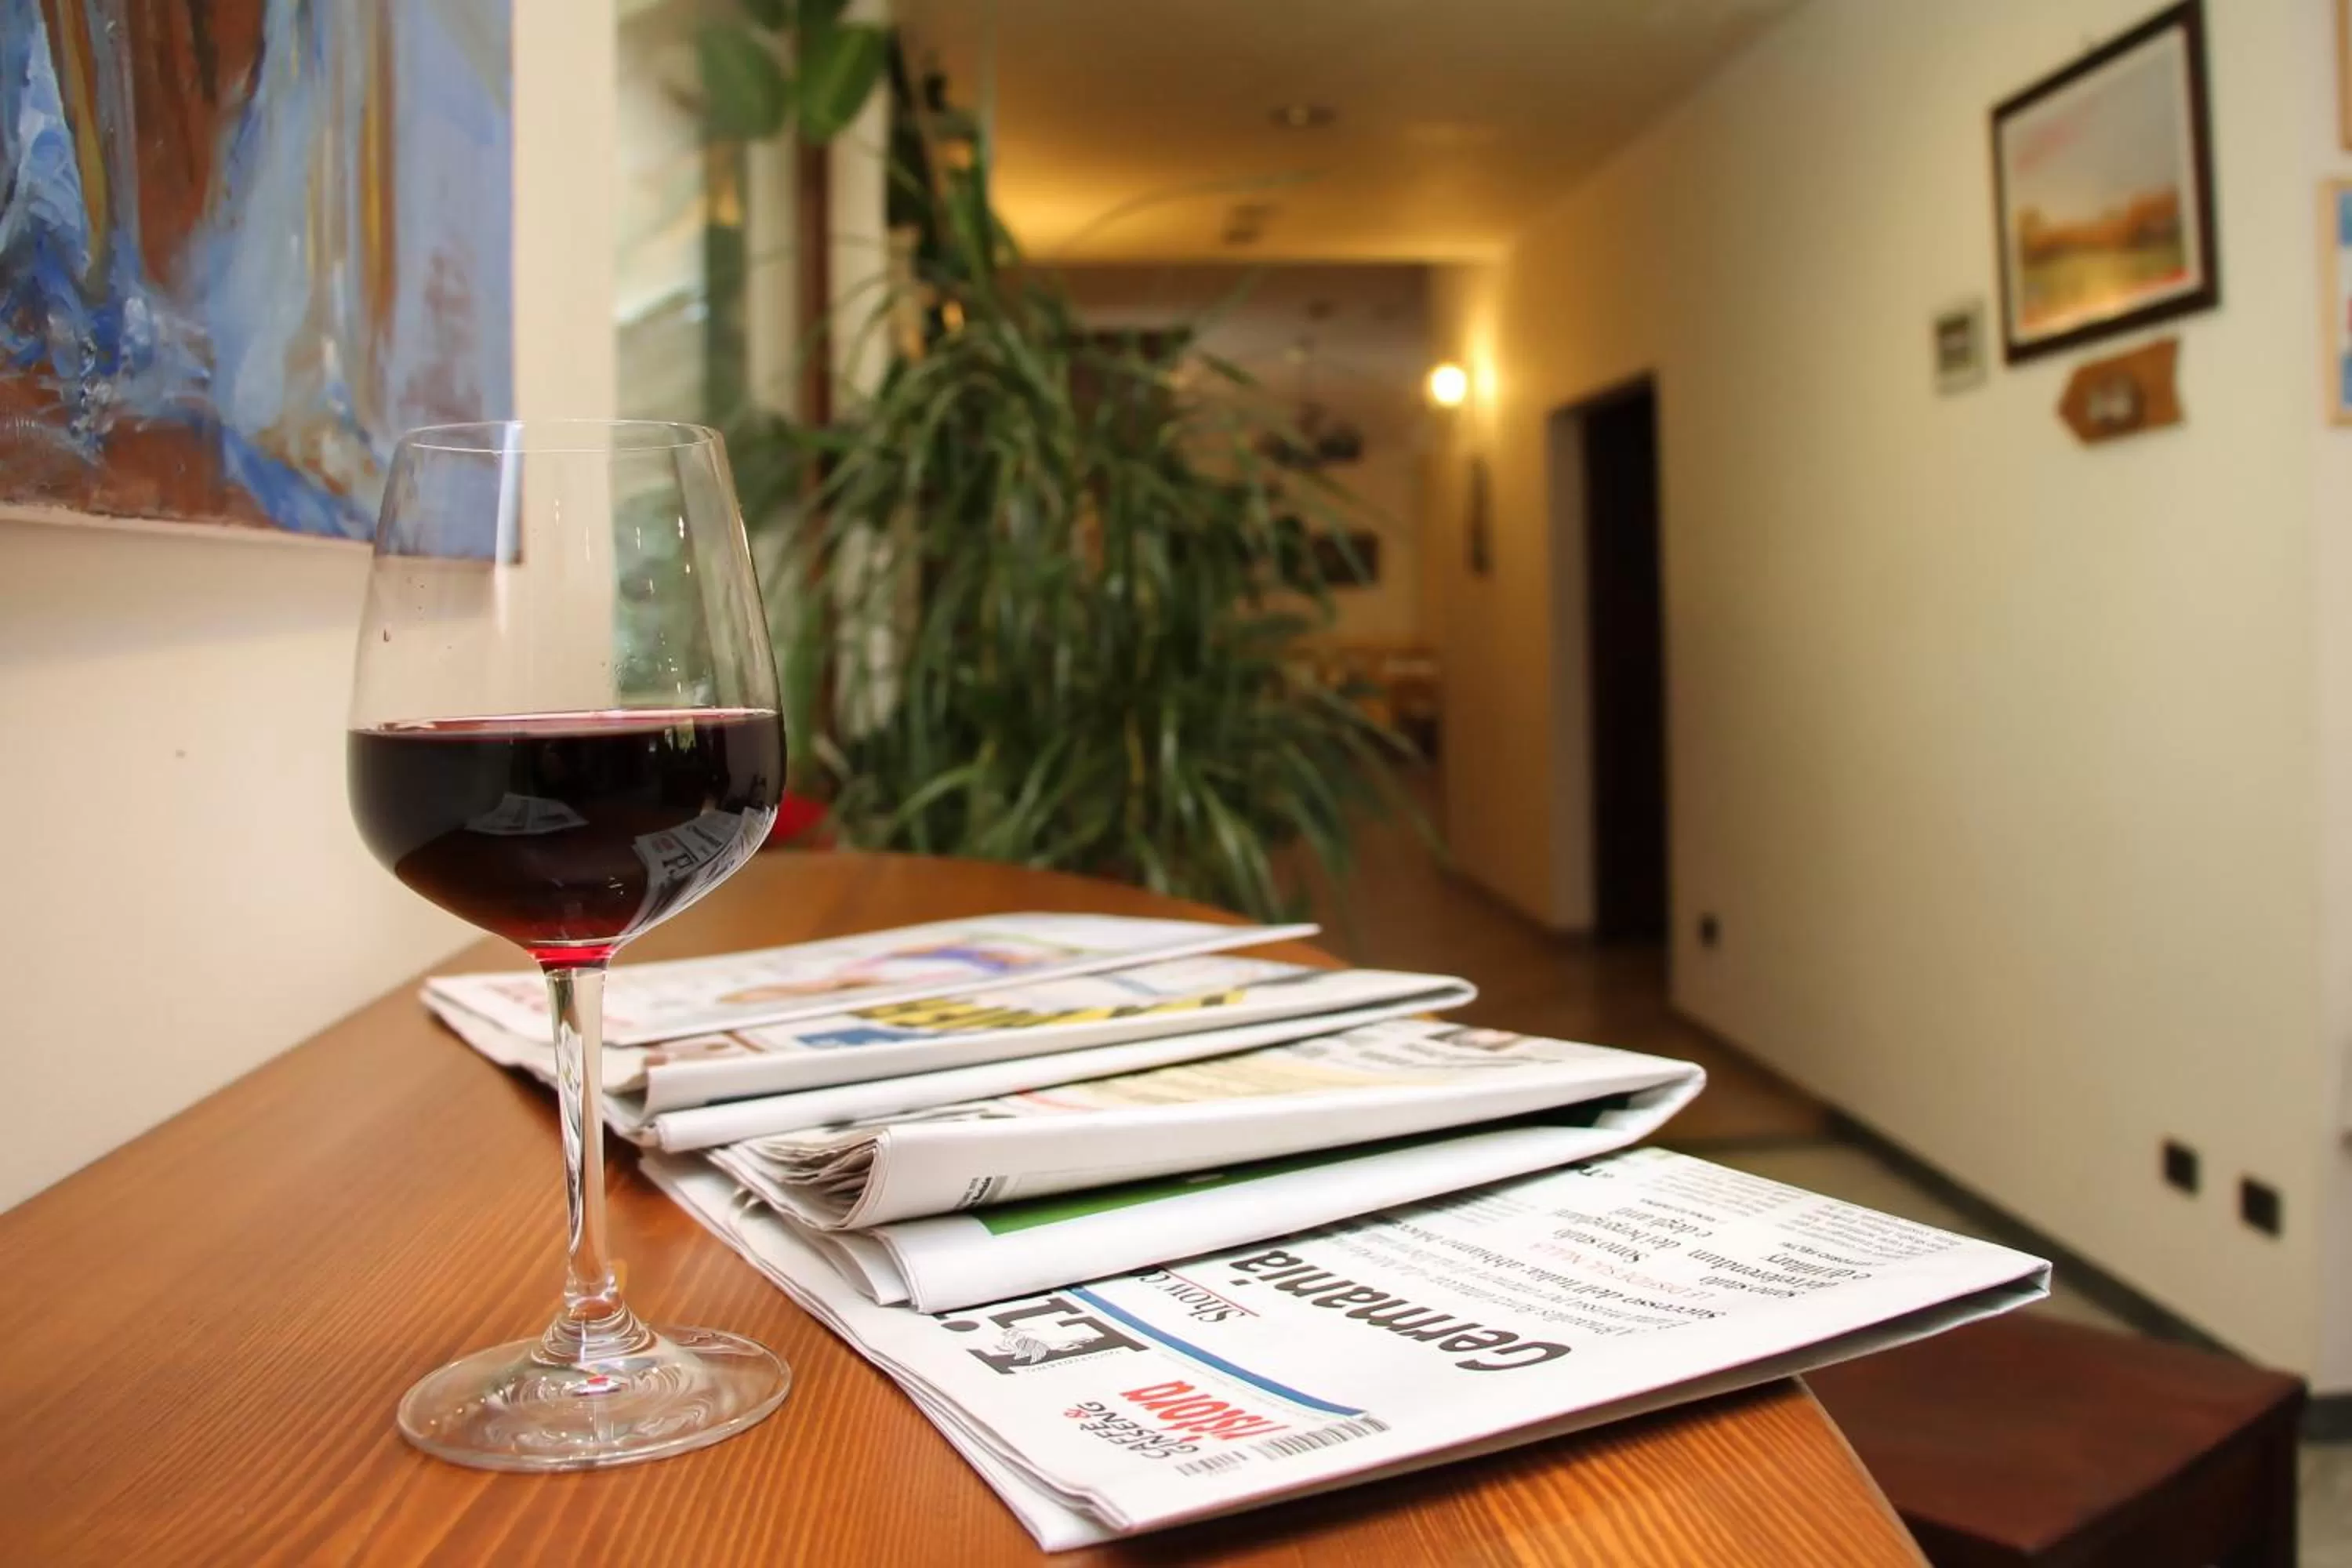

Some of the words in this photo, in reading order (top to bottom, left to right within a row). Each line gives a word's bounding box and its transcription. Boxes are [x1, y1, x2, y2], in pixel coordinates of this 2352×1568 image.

[1552, 1229, 1603, 1245] stufo
[1595, 1241, 1650, 1265] Sono
[1639, 1235, 1682, 1250] dei
[1686, 1248, 1807, 1286] referendum
[1759, 1252, 1836, 1276] Hillary
[1156, 1283, 1246, 1323] Show
[1229, 1250, 1573, 1372] Germania
[1077, 1401, 1200, 1454] GINSENG
[1119, 1380, 1291, 1443] ristora
[1080, 1421, 1172, 1459] CAFFÈ
